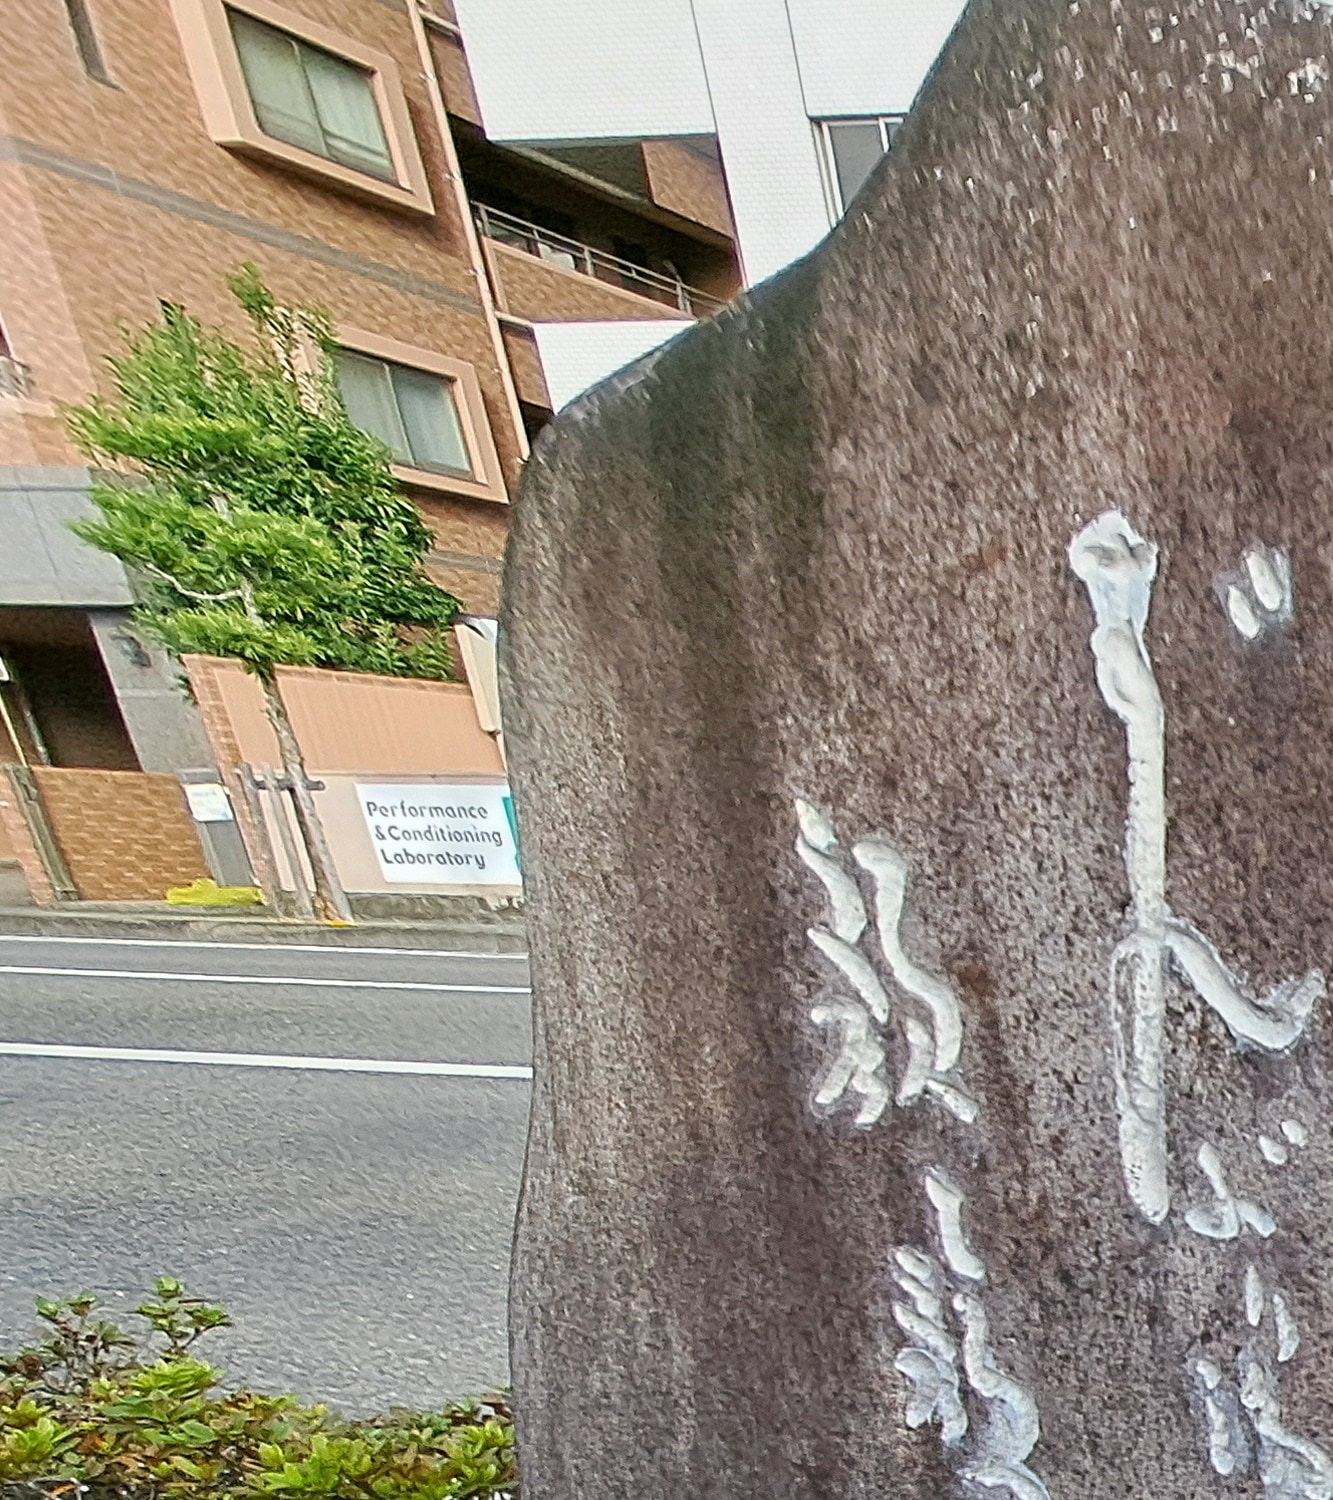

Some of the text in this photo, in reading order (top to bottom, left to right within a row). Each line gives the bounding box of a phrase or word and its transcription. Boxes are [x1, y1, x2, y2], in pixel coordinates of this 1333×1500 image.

[366, 800, 489, 819] Performance
[375, 825, 503, 847] & Conditioning
[380, 848, 486, 870] Laboratory
